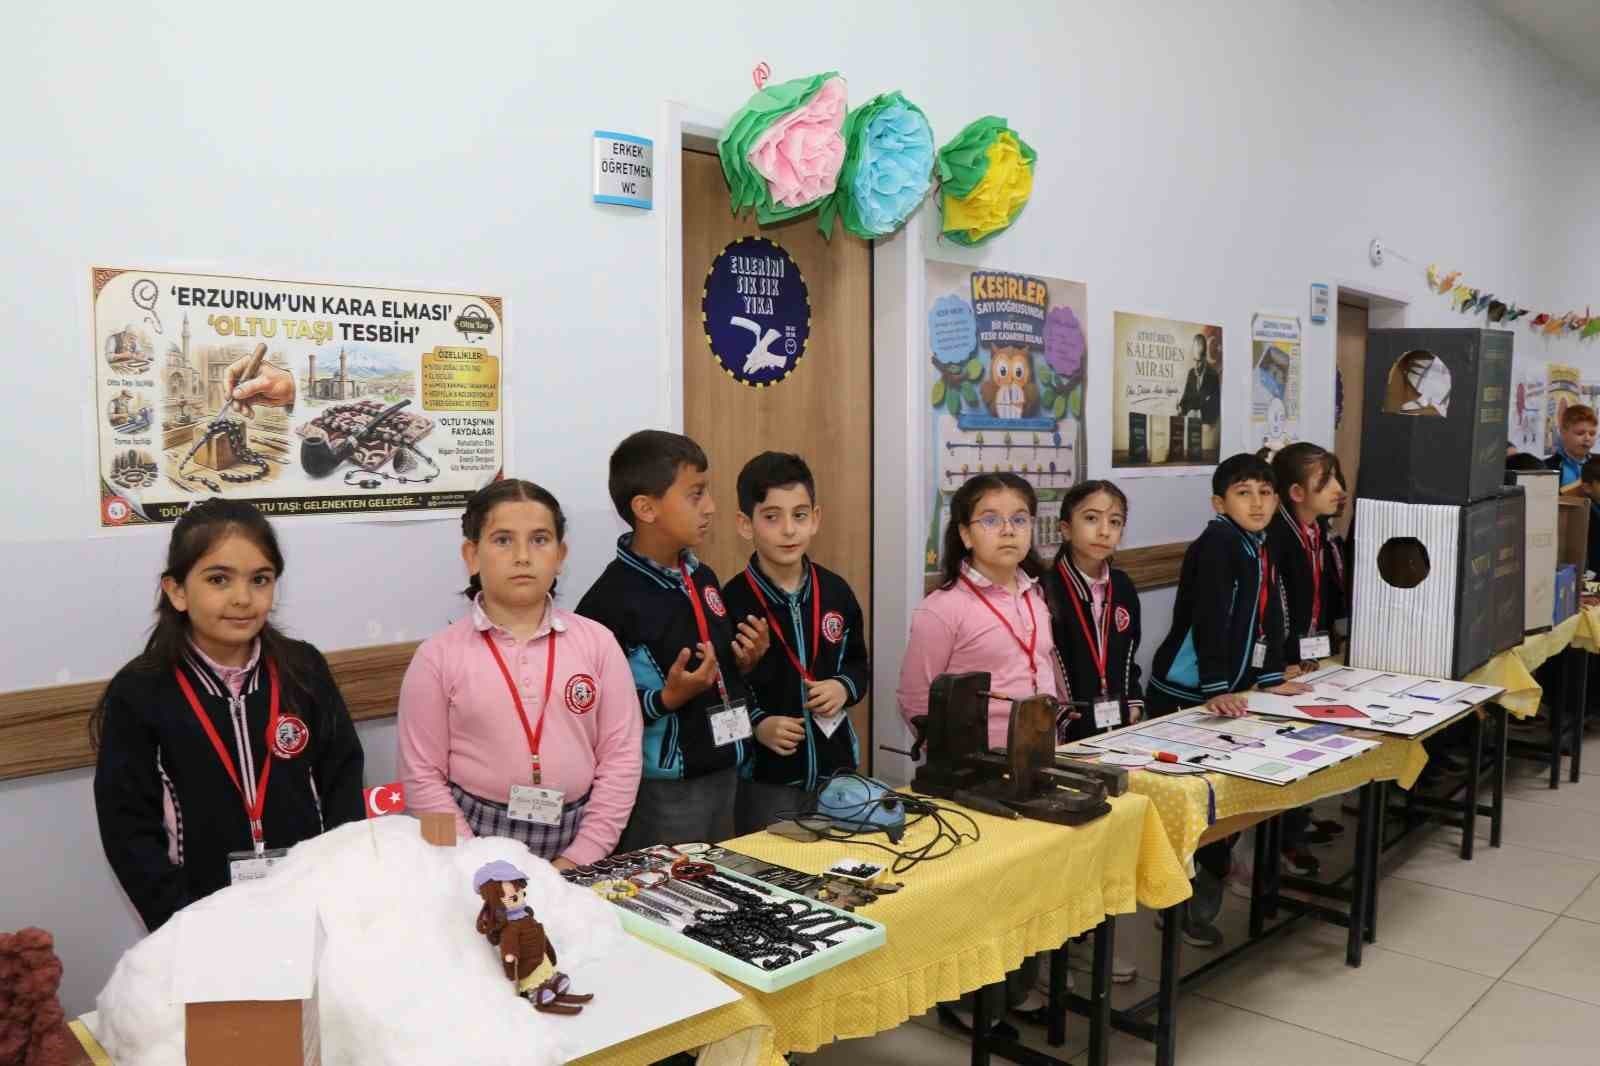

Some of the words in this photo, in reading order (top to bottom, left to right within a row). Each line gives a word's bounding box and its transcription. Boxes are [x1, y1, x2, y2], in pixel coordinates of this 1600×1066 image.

[613, 142, 643, 158] ERKEK
[601, 158, 651, 178] ÖĞRETMEN
[621, 182, 637, 194] WC
[737, 275, 757, 294] SIK
[760, 278, 780, 296] SIK
[973, 273, 1048, 306] KESİRLER
[171, 285, 316, 313] 'ERZURUM'UN
[322, 296, 377, 317] KARA
[382, 300, 452, 321] ELMASI'
[743, 295, 775, 315] YIKA
[976, 301, 995, 314] SAYI
[208, 313, 278, 337] 'OLTU
[282, 318, 335, 345] TAŞI
[339, 320, 420, 344] TESBİH'
[303, 499, 367, 510] GELENEKTEN
